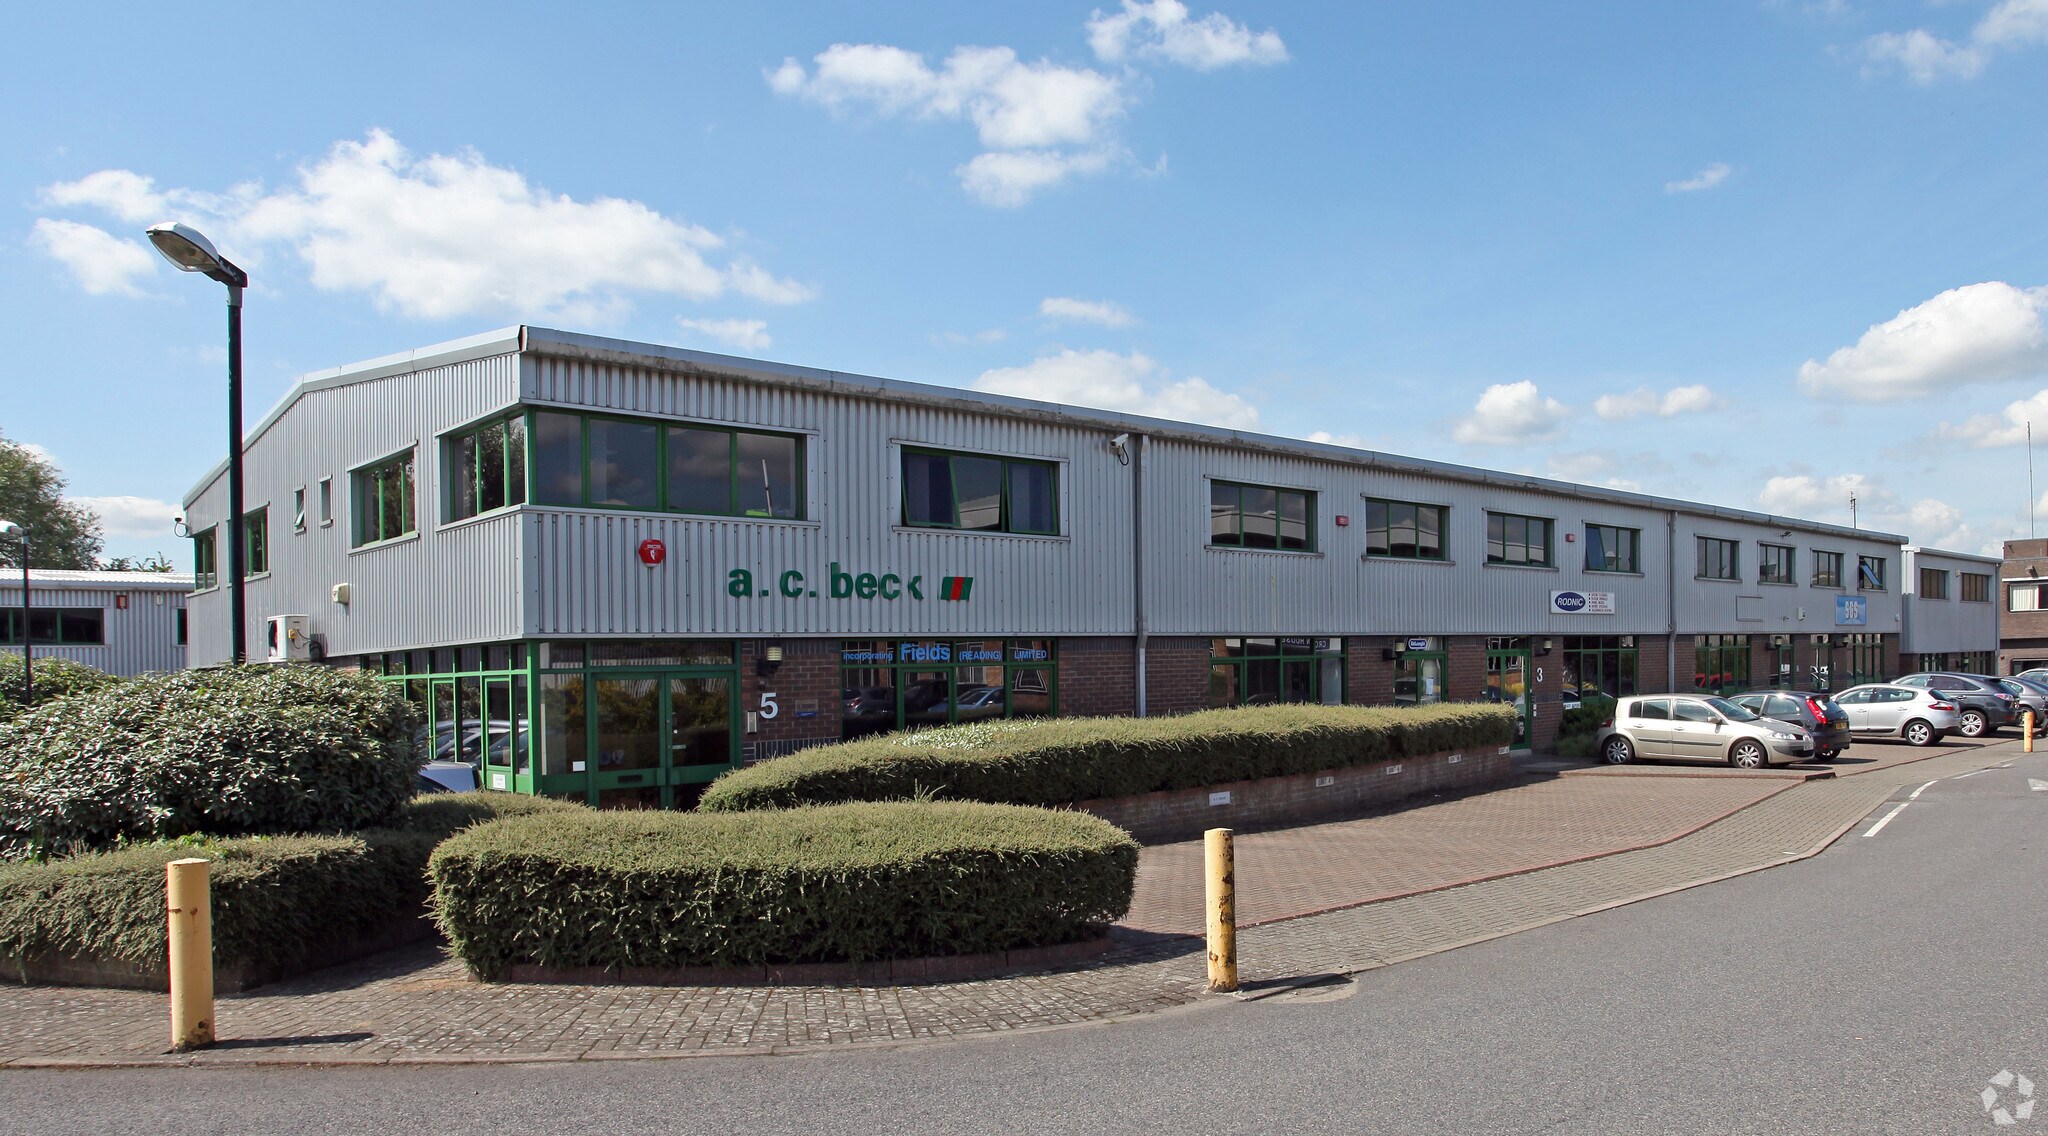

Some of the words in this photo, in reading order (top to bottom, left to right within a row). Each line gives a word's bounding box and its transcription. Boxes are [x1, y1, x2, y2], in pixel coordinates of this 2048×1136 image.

[1557, 597, 1584, 606] RODNIC
[843, 651, 893, 663] incorporating
[901, 643, 951, 661] Fields
[959, 650, 1002, 661] (READING)
[1014, 649, 1047, 659] LIMITED
[1536, 667, 1543, 682] 3
[760, 692, 779, 719] 5
